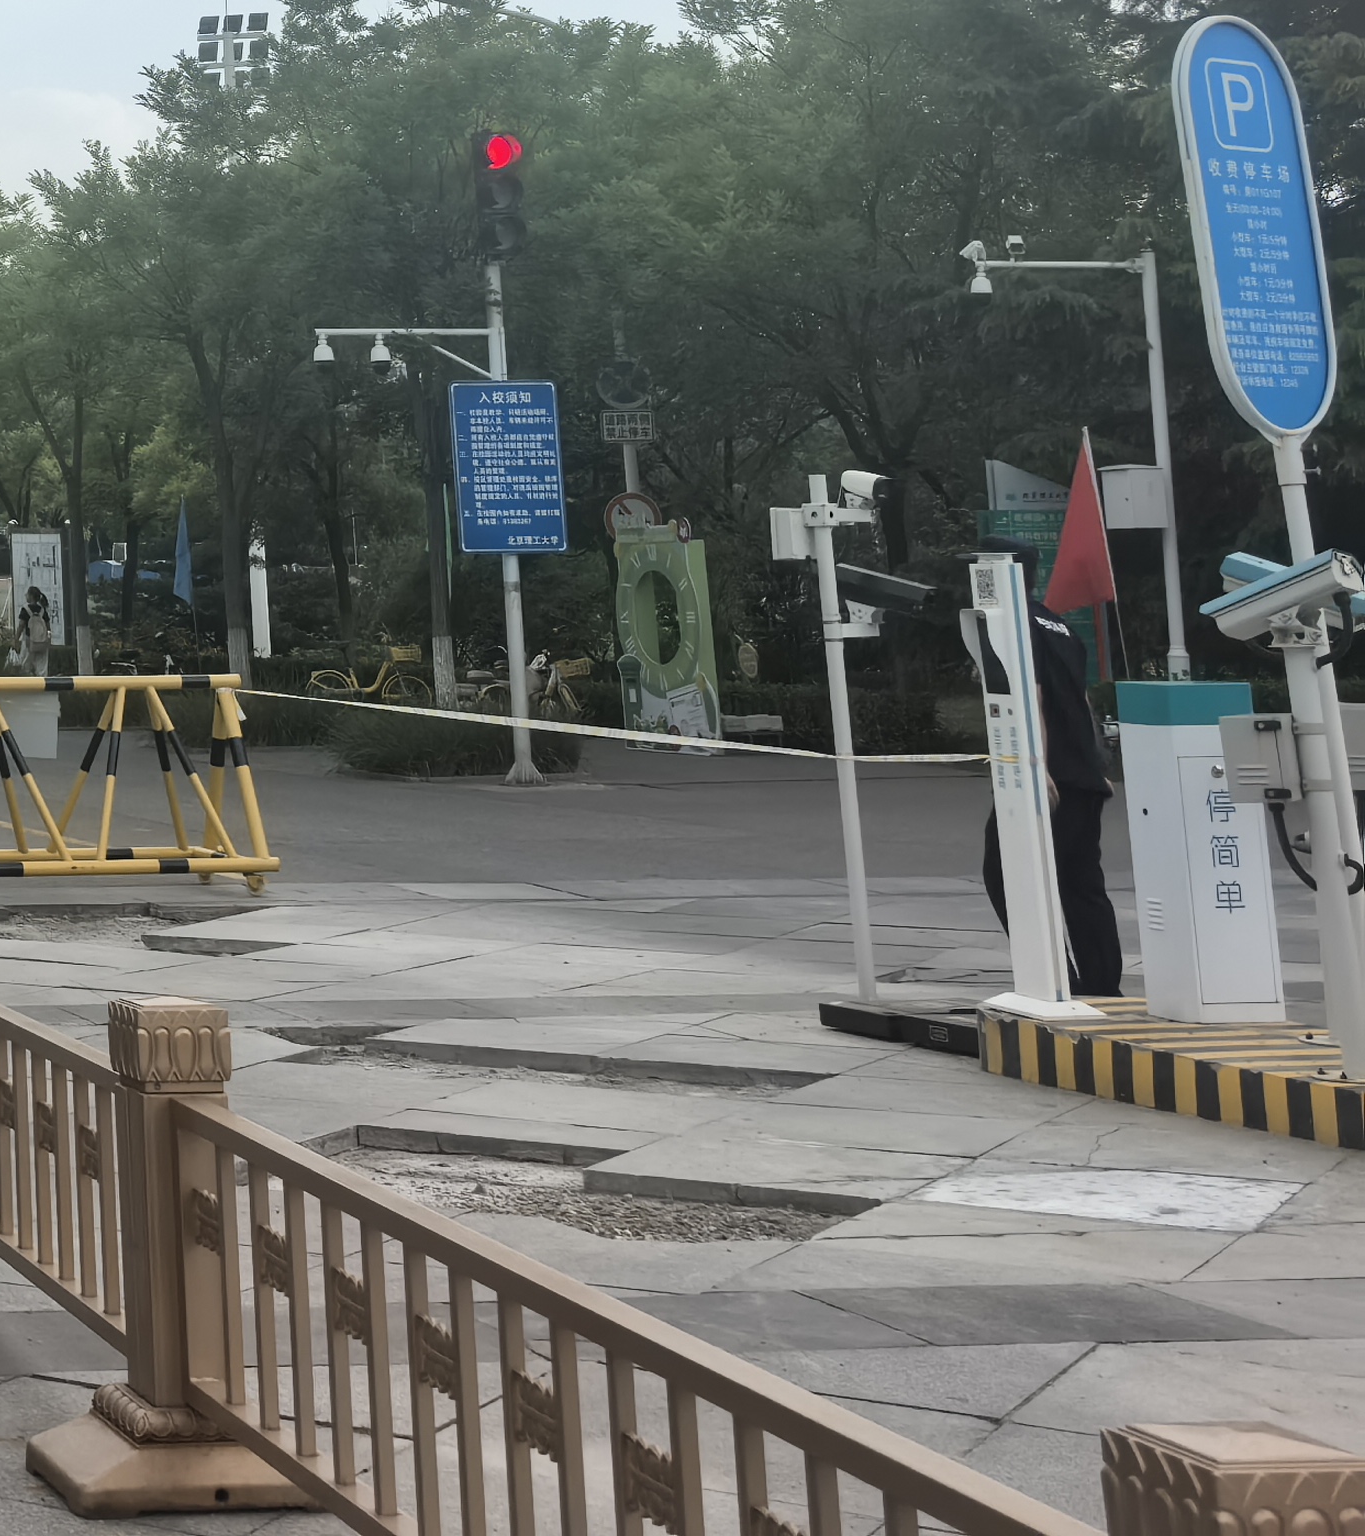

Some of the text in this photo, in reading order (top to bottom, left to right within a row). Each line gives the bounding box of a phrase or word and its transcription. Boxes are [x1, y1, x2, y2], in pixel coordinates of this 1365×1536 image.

[1220, 71, 1254, 137] P
[1207, 157, 1290, 183] 收费停车场
[479, 390, 531, 404] 入校须知
[1206, 789, 1246, 914] 停简单
